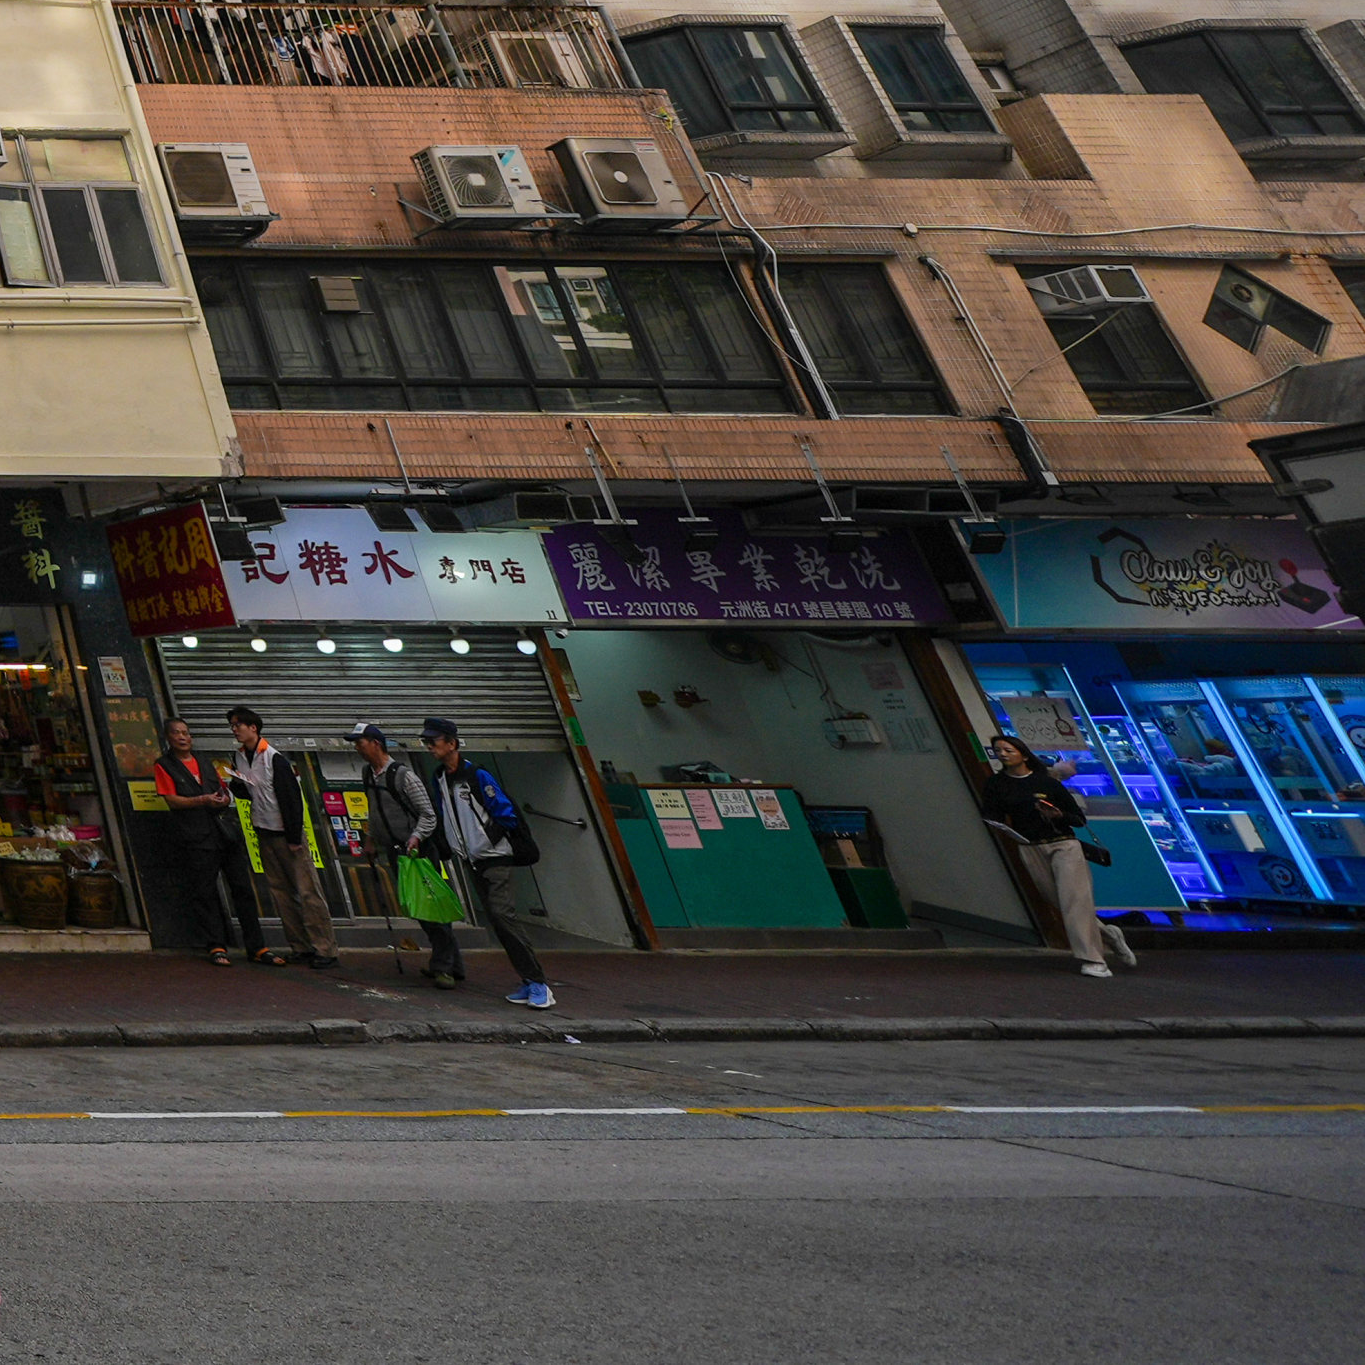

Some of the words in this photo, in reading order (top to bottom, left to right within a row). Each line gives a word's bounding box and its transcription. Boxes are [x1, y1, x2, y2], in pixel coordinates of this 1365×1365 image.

[10, 498, 61, 590] 醬料
[584, 601, 622, 617] TEL:
[624, 601, 699, 618] 23070786
[719, 601, 771, 619] 元洲街
[774, 602, 799, 618] 471
[873, 602, 893, 618] 10
[894, 601, 915, 619] 號
